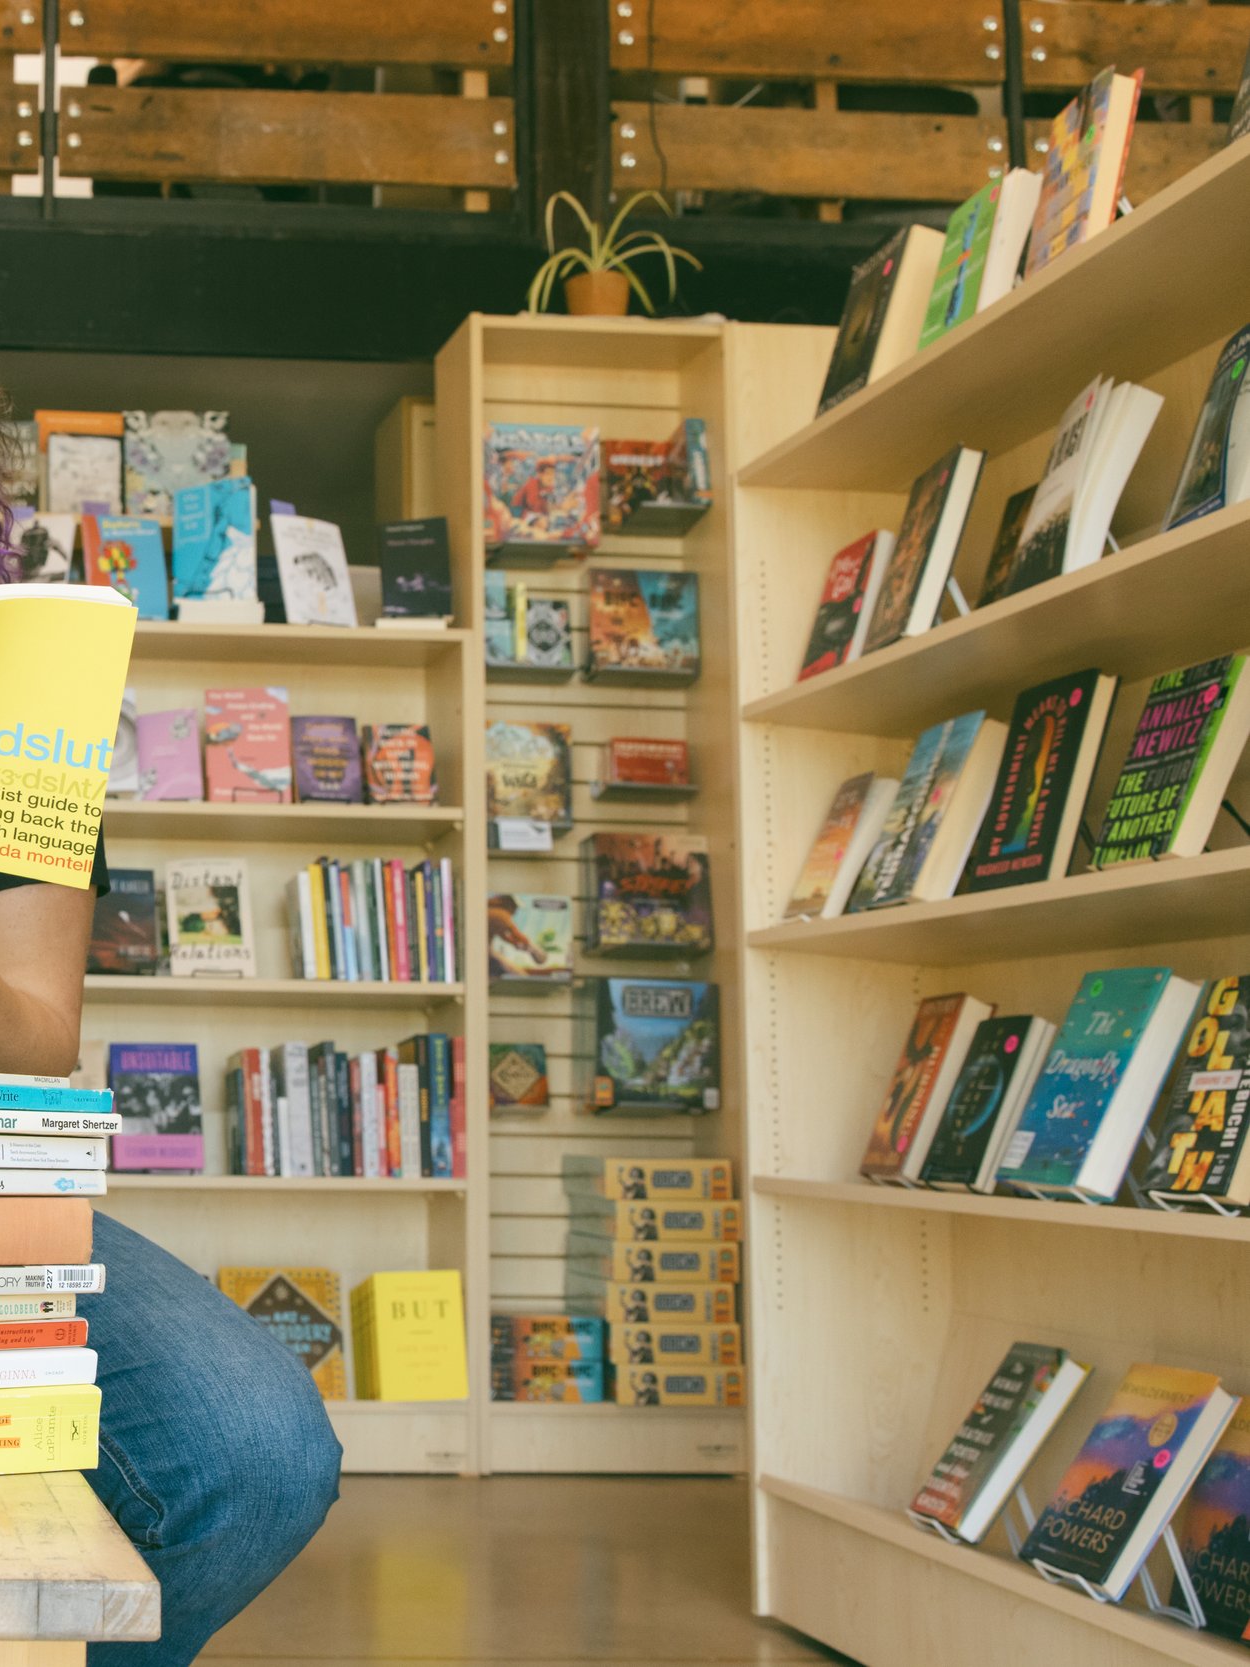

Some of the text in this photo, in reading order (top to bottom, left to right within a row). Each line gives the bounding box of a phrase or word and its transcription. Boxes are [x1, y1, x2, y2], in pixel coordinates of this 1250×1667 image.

[1133, 717, 1203, 759] NEWITZ
[1117, 769, 1147, 796] THE
[27, 795, 79, 813] guide
[84, 803, 102, 818] to
[1158, 784, 1180, 810] OF
[21, 810, 65, 830] back
[70, 819, 98, 836] the
[1107, 808, 1177, 843] ANOTHER
[13, 827, 95, 856] language
[26, 851, 93, 873] montell
[171, 869, 243, 890] Distant
[169, 942, 252, 961] Relations
[1085, 1011, 1116, 1036] The
[1046, 1050, 1121, 1081] Dragonfly
[34, 1076, 61, 1084] MACMILLAN
[42, 1117, 118, 1133] Margaret Shertzer
[45, 1269, 53, 1289] 227
[391, 1299, 450, 1321] BUT
[24, 1335, 35, 1343] Life
[0, 1369, 37, 1381] GINNA
[35, 1416, 44, 1451] Alice
[47, 1405, 57, 1461] LaPlante
[1051, 1489, 1127, 1530] RICHARD
[1041, 1516, 1115, 1554] POWERS
[1184, 1546, 1250, 1581] RICHAR
[1190, 1573, 1250, 1615] OWER
